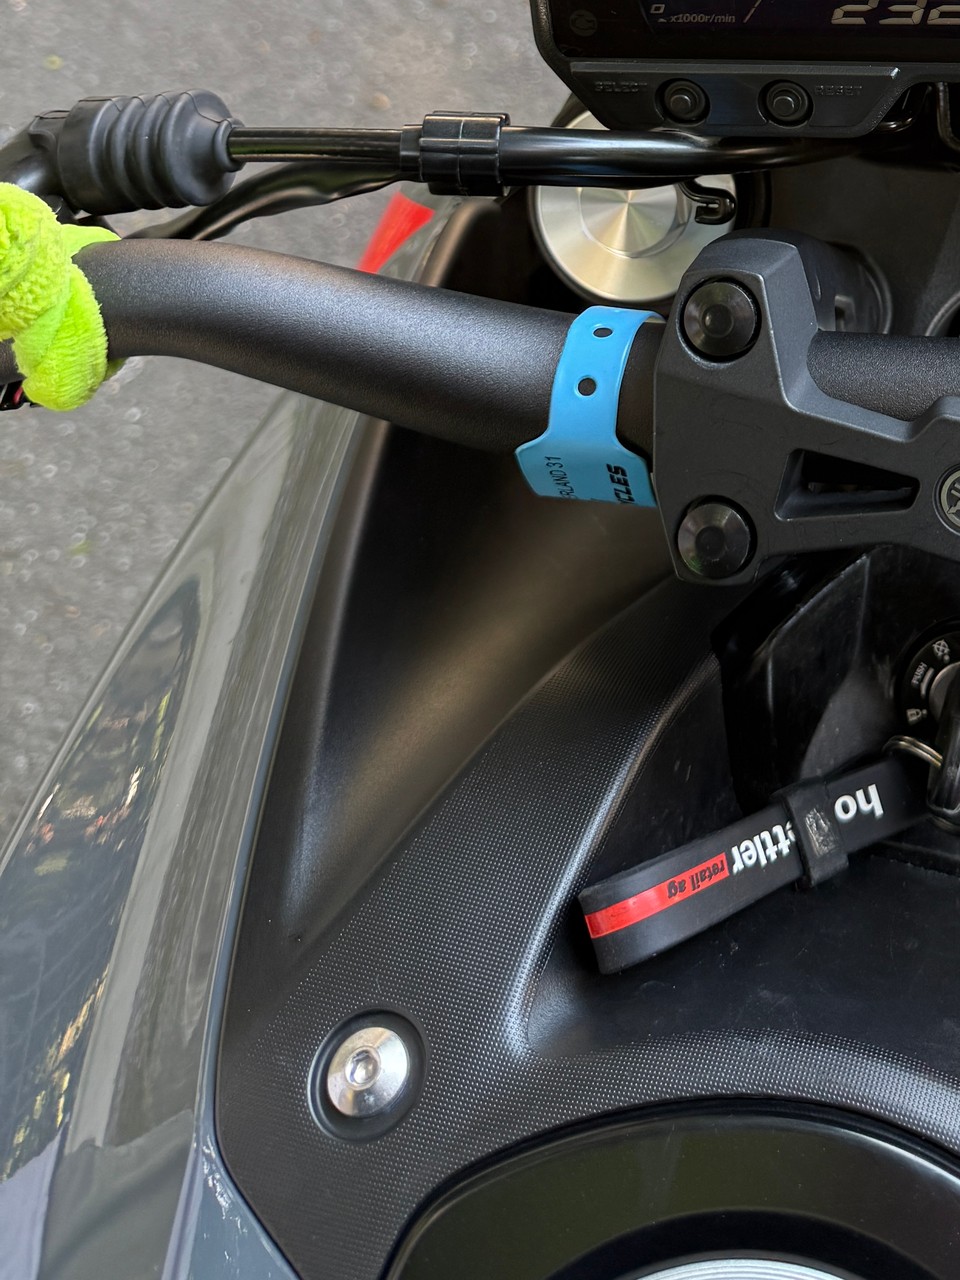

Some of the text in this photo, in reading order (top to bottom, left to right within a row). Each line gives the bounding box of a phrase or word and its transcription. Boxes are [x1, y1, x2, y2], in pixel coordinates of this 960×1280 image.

[650, 4, 666, 14] 0
[669, 13, 736, 23] x1000r/min
[910, 661, 928, 686] PUSH
[667, 858, 726, 899] retail ag
